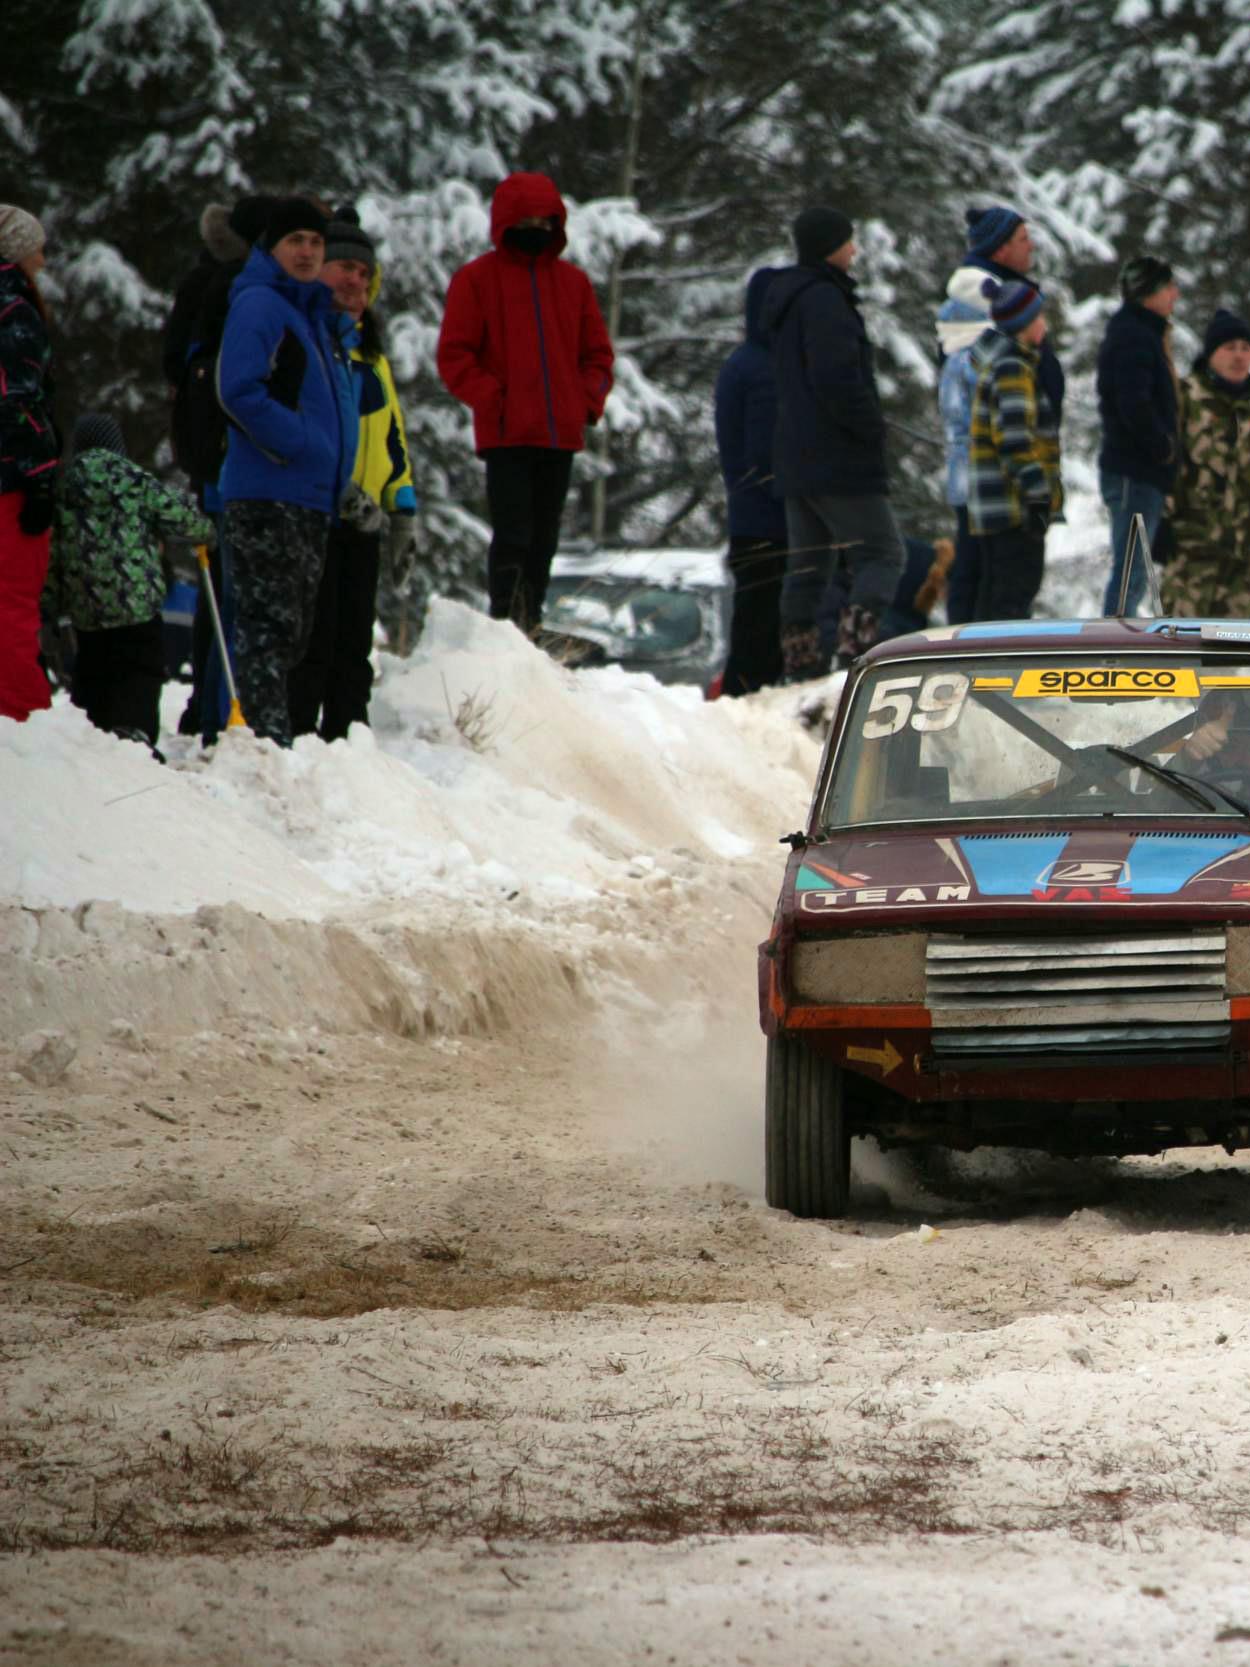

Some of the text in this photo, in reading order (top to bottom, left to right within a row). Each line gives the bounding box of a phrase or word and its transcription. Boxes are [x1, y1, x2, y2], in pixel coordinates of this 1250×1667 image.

[1040, 670, 1176, 693] sparco
[862, 672, 970, 739] 59
[815, 886, 971, 906] TEAM
